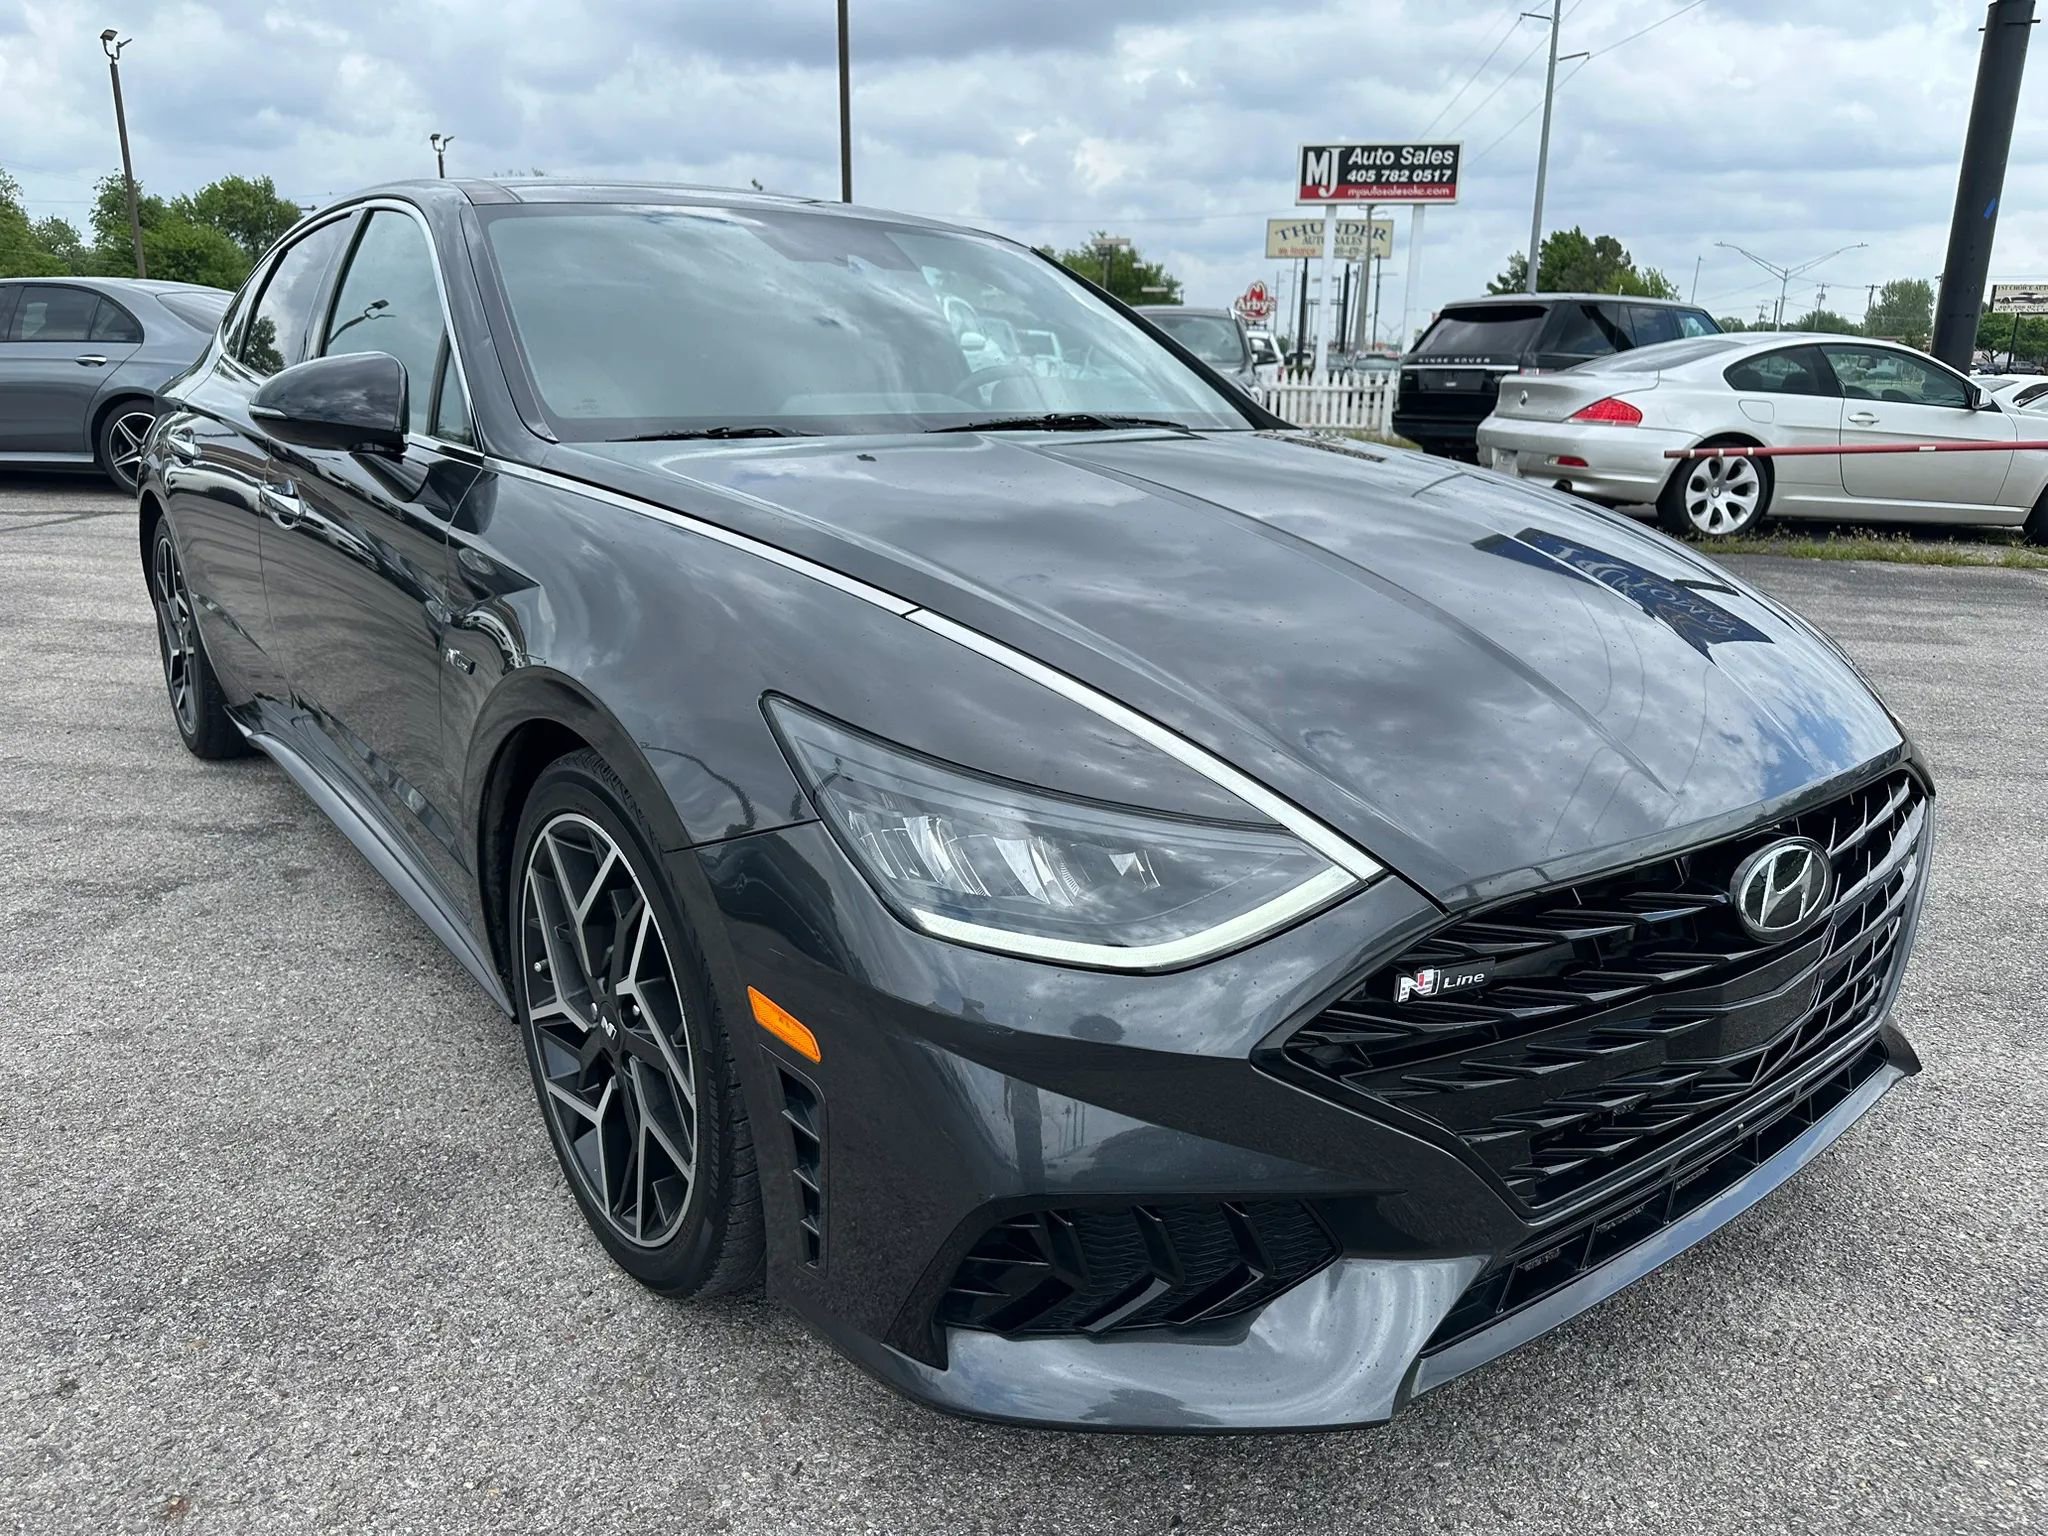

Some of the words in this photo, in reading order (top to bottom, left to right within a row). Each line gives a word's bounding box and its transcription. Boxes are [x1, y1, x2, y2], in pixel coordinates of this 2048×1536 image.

[1348, 147, 1395, 165] Auto
[1400, 147, 1454, 165] Sales
[1306, 148, 1345, 197] MJ
[1347, 170, 1376, 182] 405
[1381, 170, 1408, 182] 782
[1413, 170, 1452, 182] 0517
[1443, 973, 1485, 989] Line
